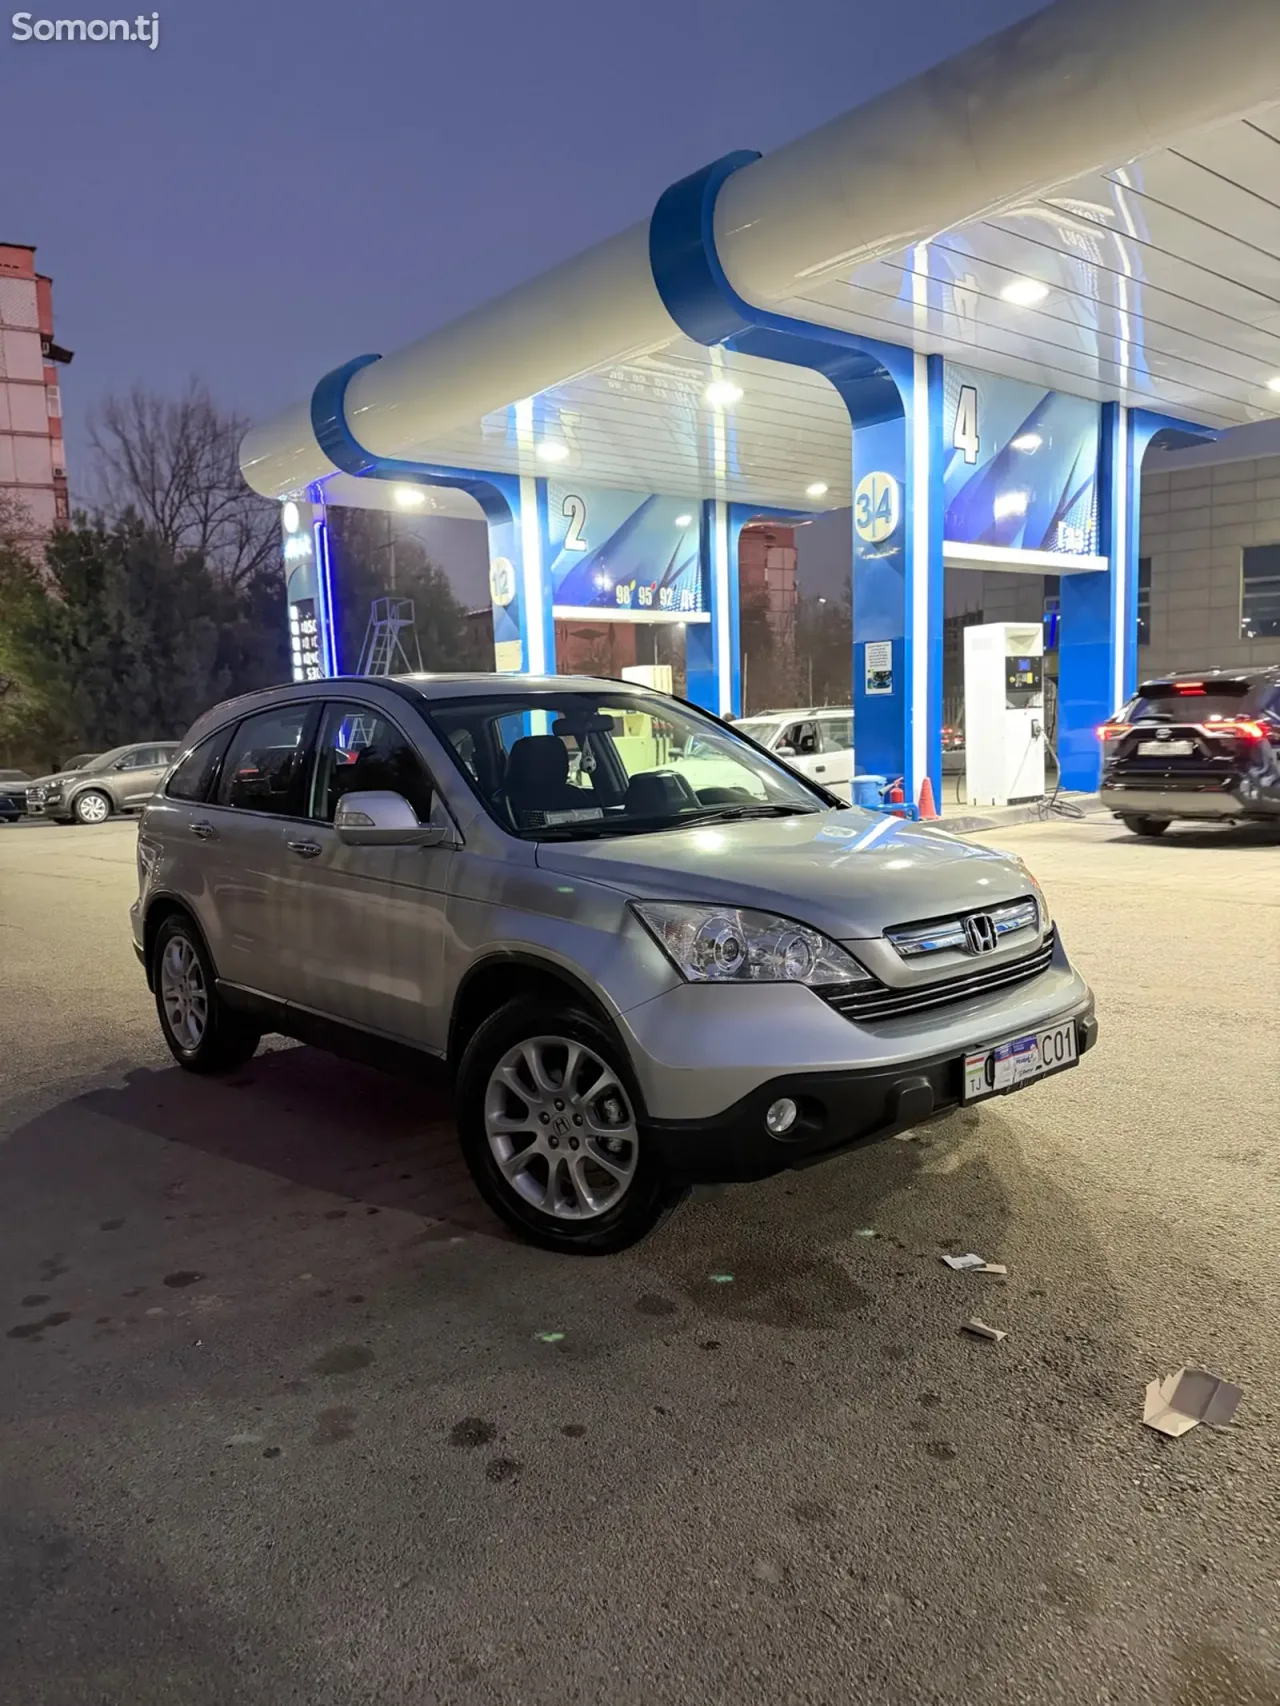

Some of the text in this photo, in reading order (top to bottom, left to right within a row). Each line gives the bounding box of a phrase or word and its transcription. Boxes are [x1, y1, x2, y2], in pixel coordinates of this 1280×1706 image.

[953, 384, 979, 465] 4
[562, 494, 587, 551] 2
[616, 585, 630, 604] 98
[638, 586, 652, 605] 95
[660, 587, 673, 606] 92
[1042, 1027, 1071, 1066] C01
[970, 1077, 982, 1093] TJ
